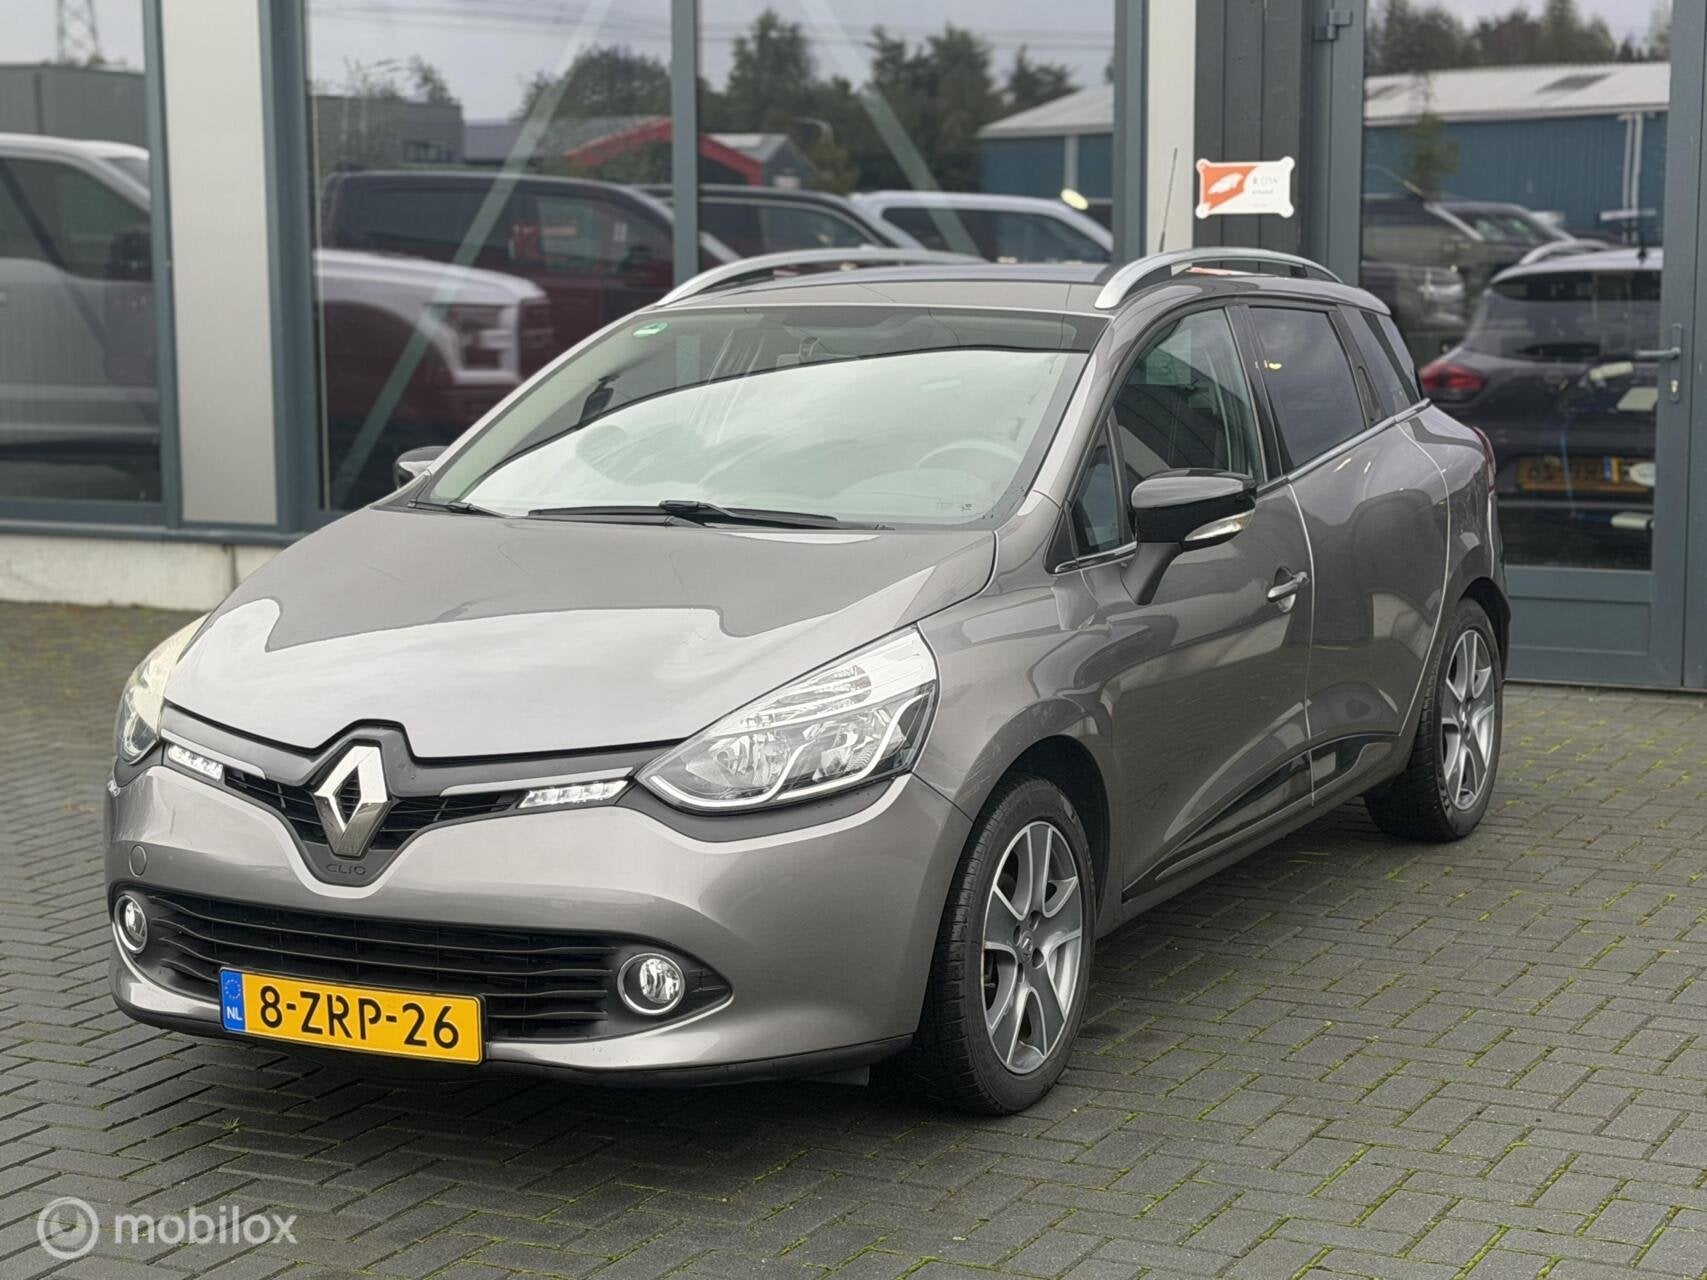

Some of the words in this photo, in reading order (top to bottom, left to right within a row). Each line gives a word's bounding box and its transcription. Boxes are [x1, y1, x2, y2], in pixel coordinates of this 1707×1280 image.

[326, 863, 366, 876] CLIO
[226, 1005, 243, 1021] NL
[260, 985, 459, 1049] 8-ZRP-26
